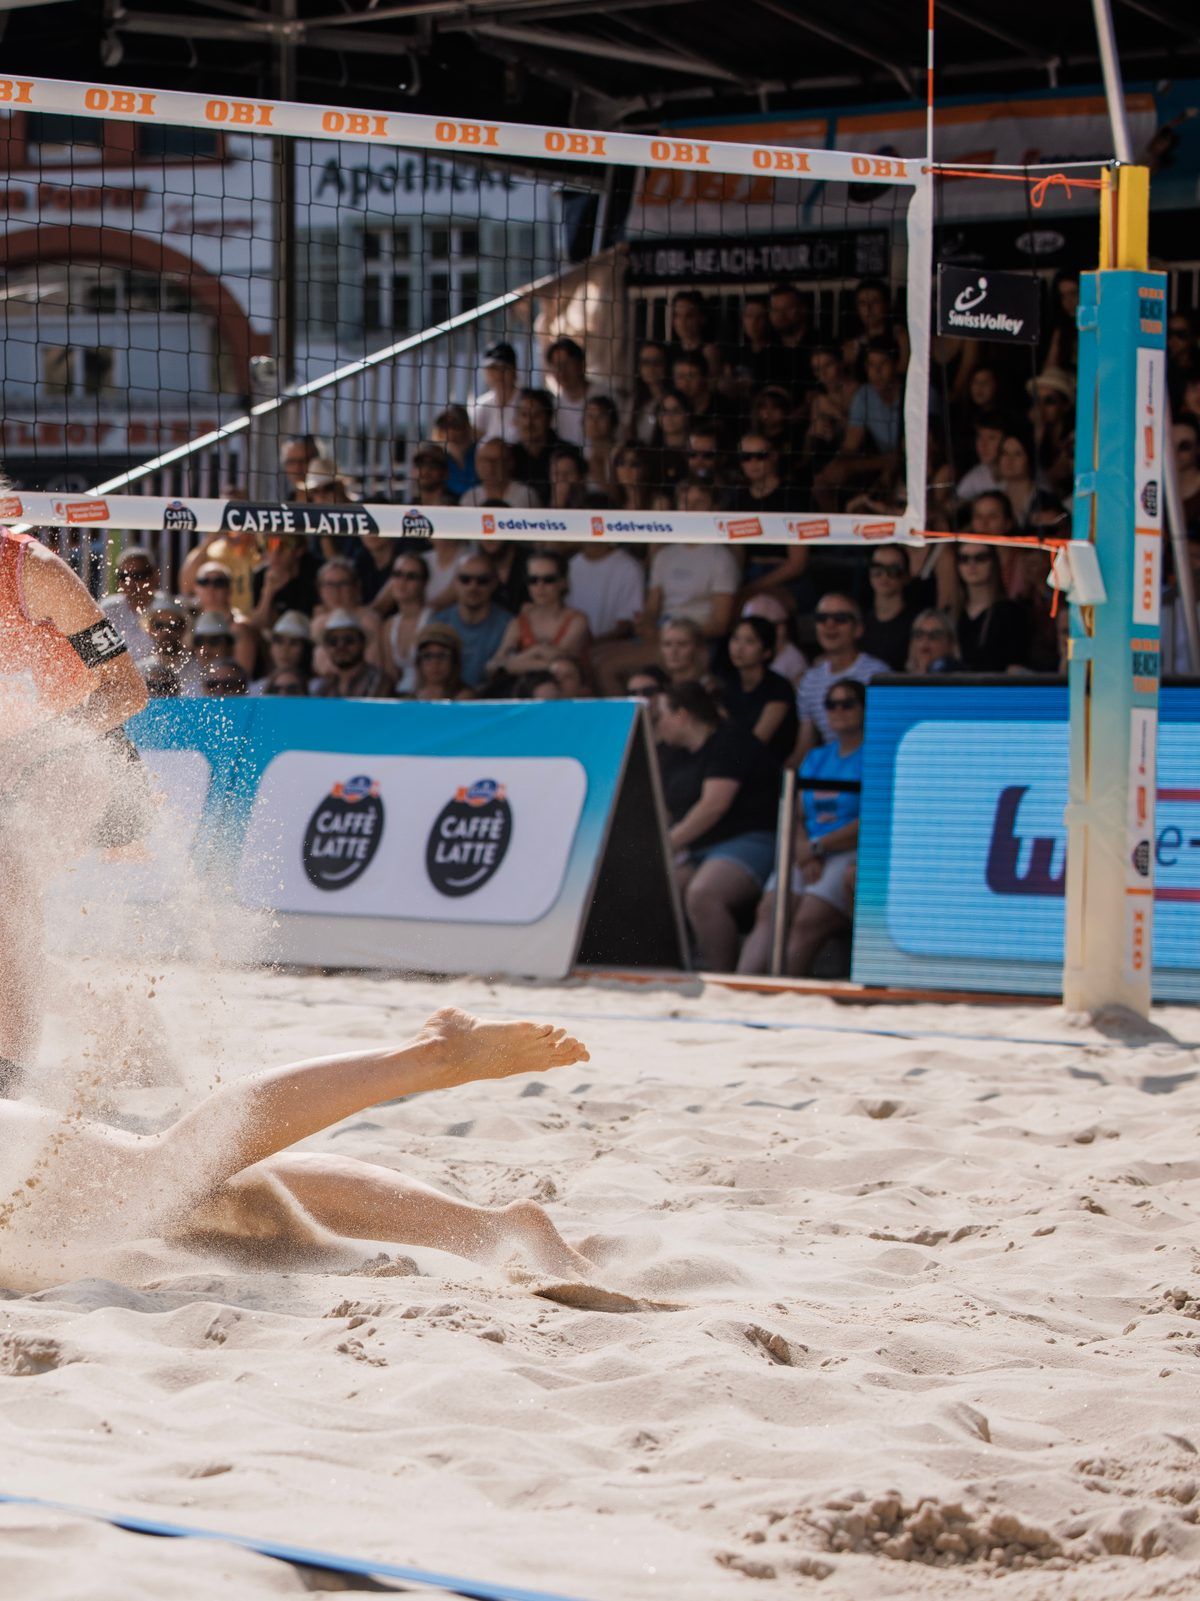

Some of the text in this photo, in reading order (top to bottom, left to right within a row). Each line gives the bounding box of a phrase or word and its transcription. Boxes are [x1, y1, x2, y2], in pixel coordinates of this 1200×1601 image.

[84, 88, 155, 115] OBI
[205, 100, 273, 126] OBI
[322, 111, 388, 137] OBI
[435, 122, 498, 146] OBI
[544, 132, 606, 156] OBI
[651, 141, 710, 164] OBI
[753, 150, 810, 171] OBI
[852, 157, 907, 177] OBI
[948, 310, 1023, 335] SwissVolley
[166, 520, 195, 530] LATTE
[227, 503, 370, 535] CAFFÈ LATTE
[498, 518, 567, 531] edelweiss
[606, 520, 673, 534] edelweiss
[316, 806, 377, 835] CAFFÈ
[439, 811, 505, 838] CAFFÈ
[311, 837, 371, 860] LATTE
[435, 842, 497, 866] LATTE
